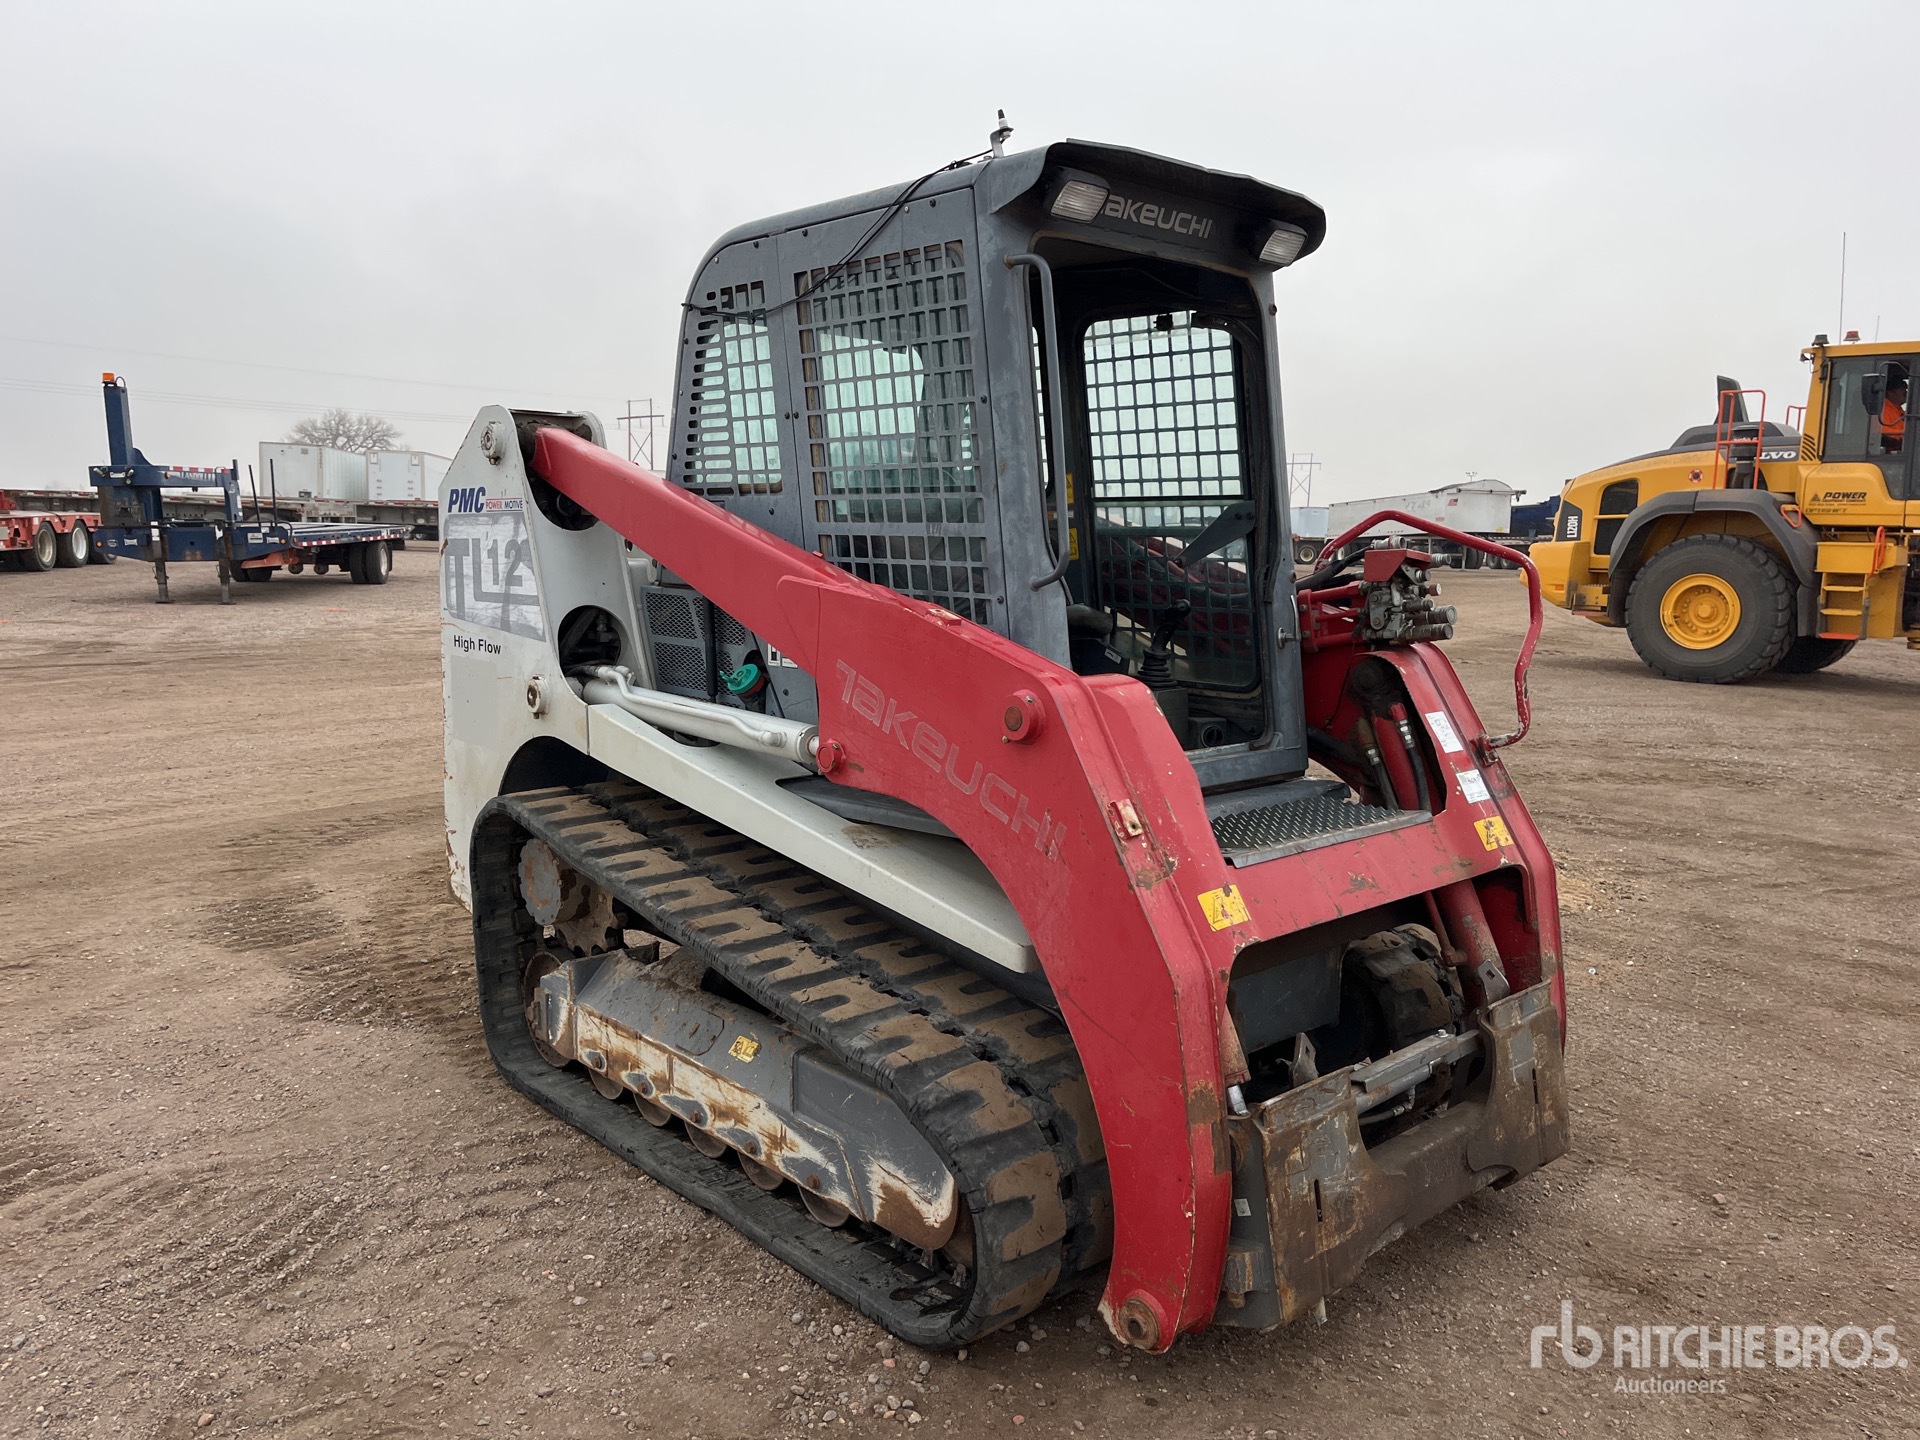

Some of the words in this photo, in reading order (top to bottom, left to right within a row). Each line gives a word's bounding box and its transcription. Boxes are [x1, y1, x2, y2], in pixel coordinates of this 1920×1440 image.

[447, 486, 486, 513] PMC
[485, 501, 503, 510] POWER
[504, 500, 523, 509] MOTIVE
[1823, 491, 1867, 499] POWER
[1566, 515, 1579, 538] L120H
[453, 634, 476, 652] High
[478, 638, 502, 655] Flow
